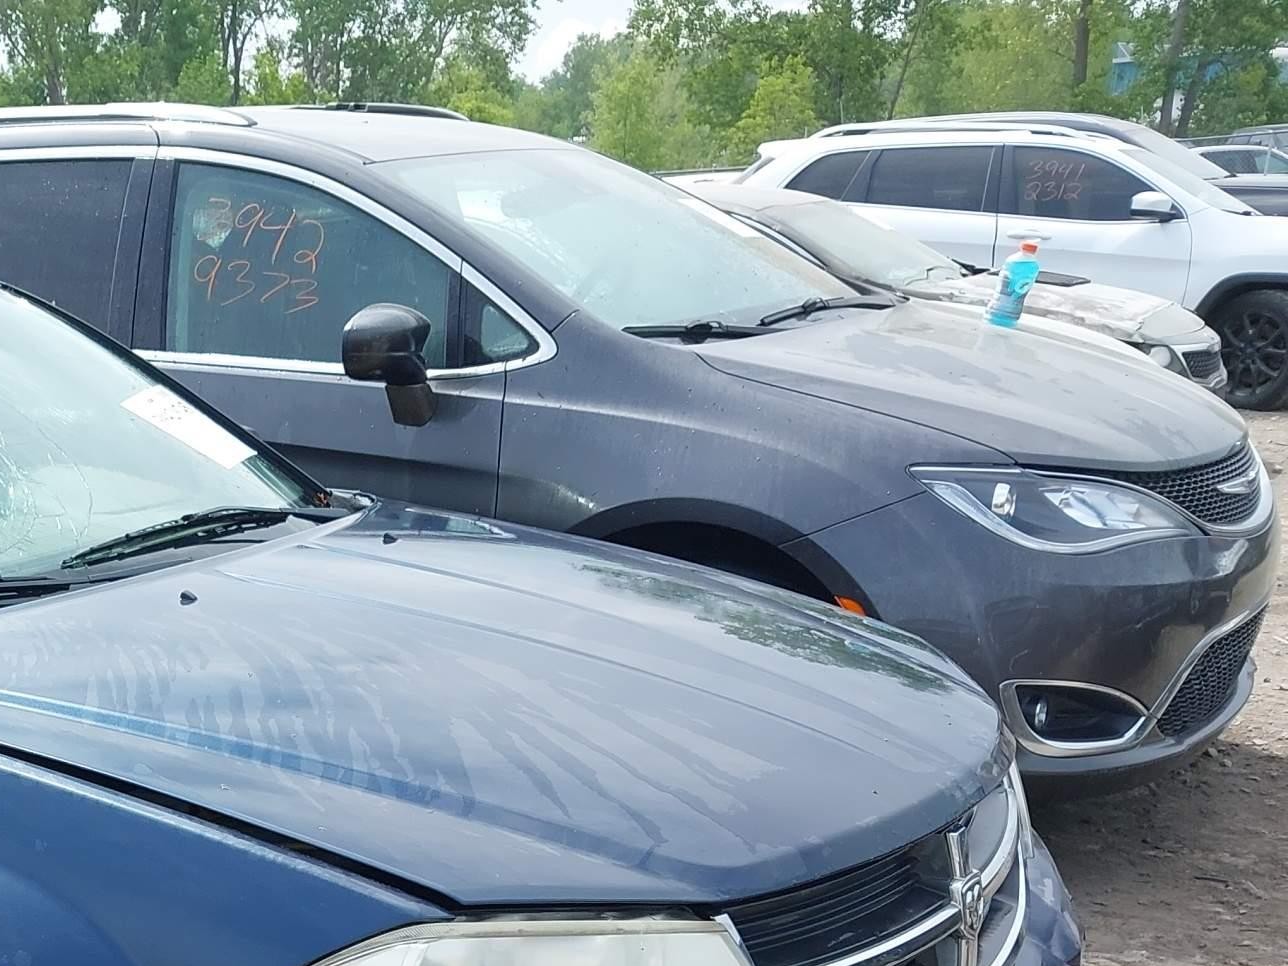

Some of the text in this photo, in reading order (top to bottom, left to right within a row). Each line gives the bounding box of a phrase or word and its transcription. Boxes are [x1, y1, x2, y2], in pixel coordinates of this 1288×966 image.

[1025, 160, 1086, 181] 3941
[1023, 181, 1082, 201] 2312
[196, 197, 326, 273] 3942
[193, 254, 319, 314] 9373
